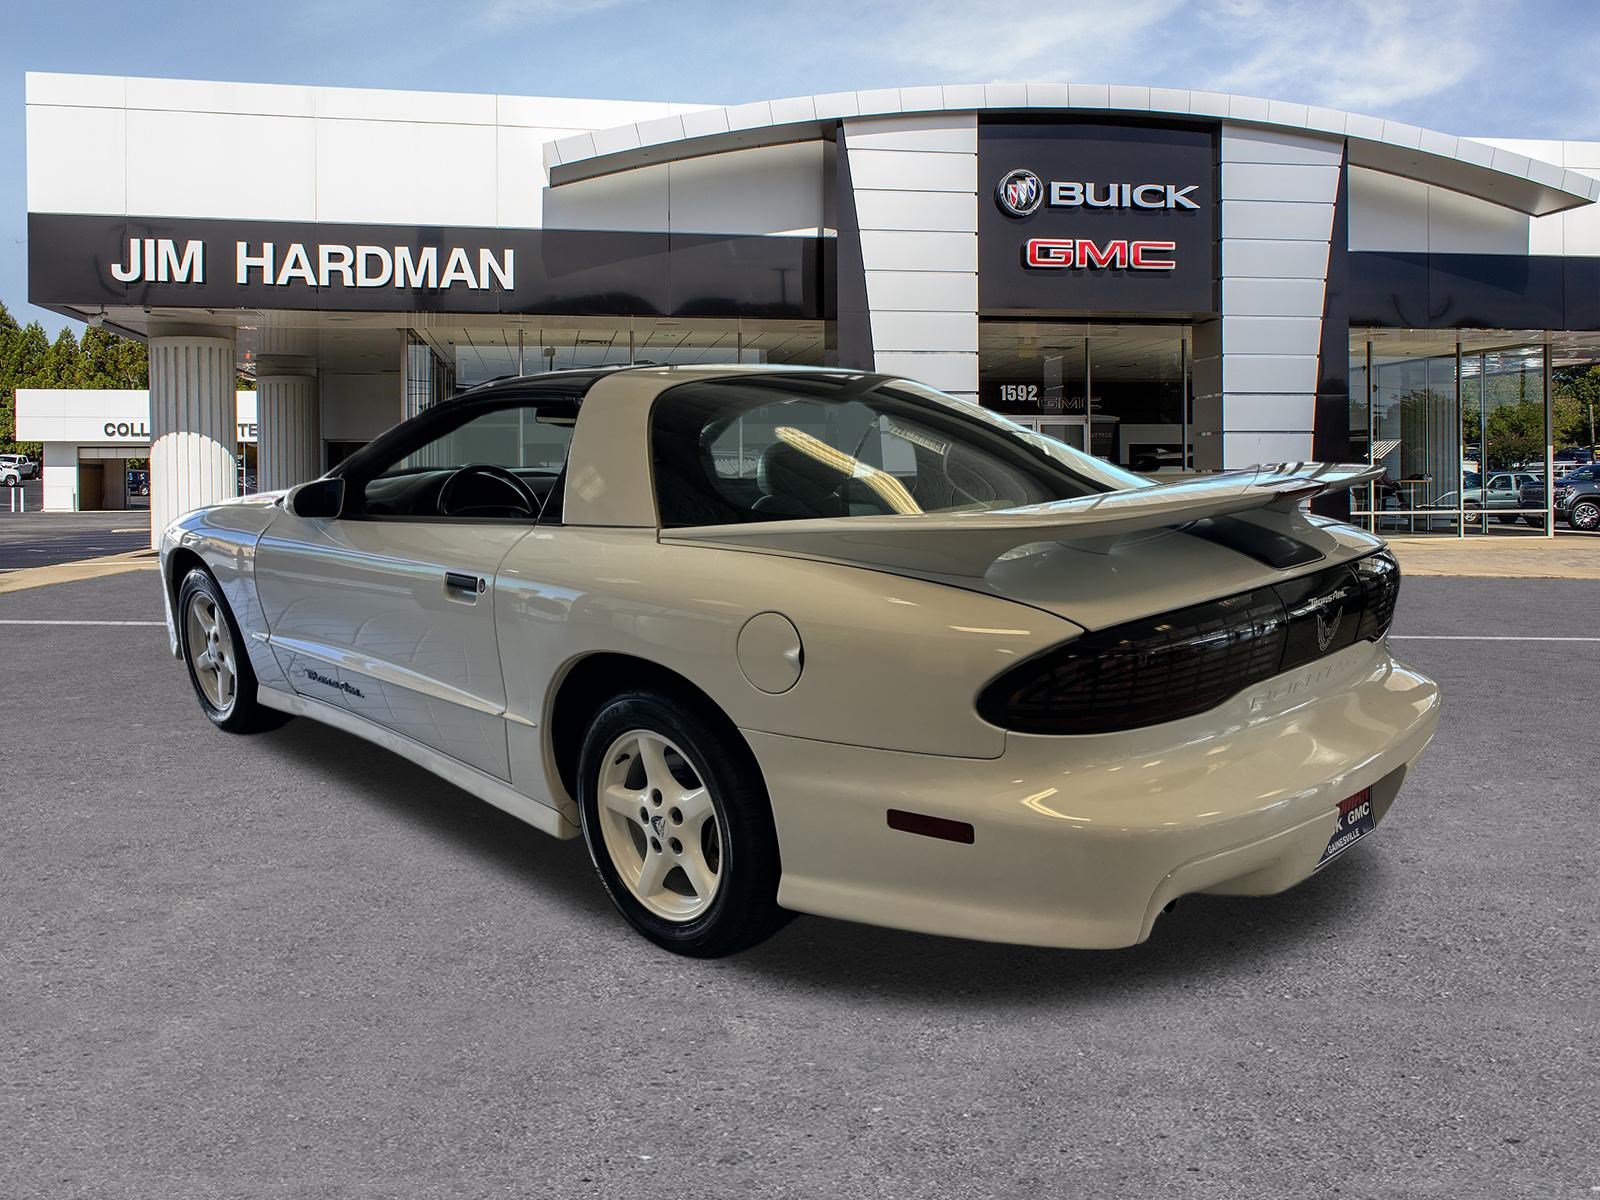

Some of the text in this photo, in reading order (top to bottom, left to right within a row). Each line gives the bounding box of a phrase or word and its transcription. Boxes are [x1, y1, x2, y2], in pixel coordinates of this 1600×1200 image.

[1050, 181, 1200, 209] BUICK
[111, 238, 515, 291] JIM HARDMAN
[1026, 238, 1176, 270] GMC
[1000, 384, 1038, 401] 1592
[103, 422, 150, 437] COLL
[1347, 801, 1370, 825] GMC
[1327, 827, 1360, 854] GAINESVILLE
